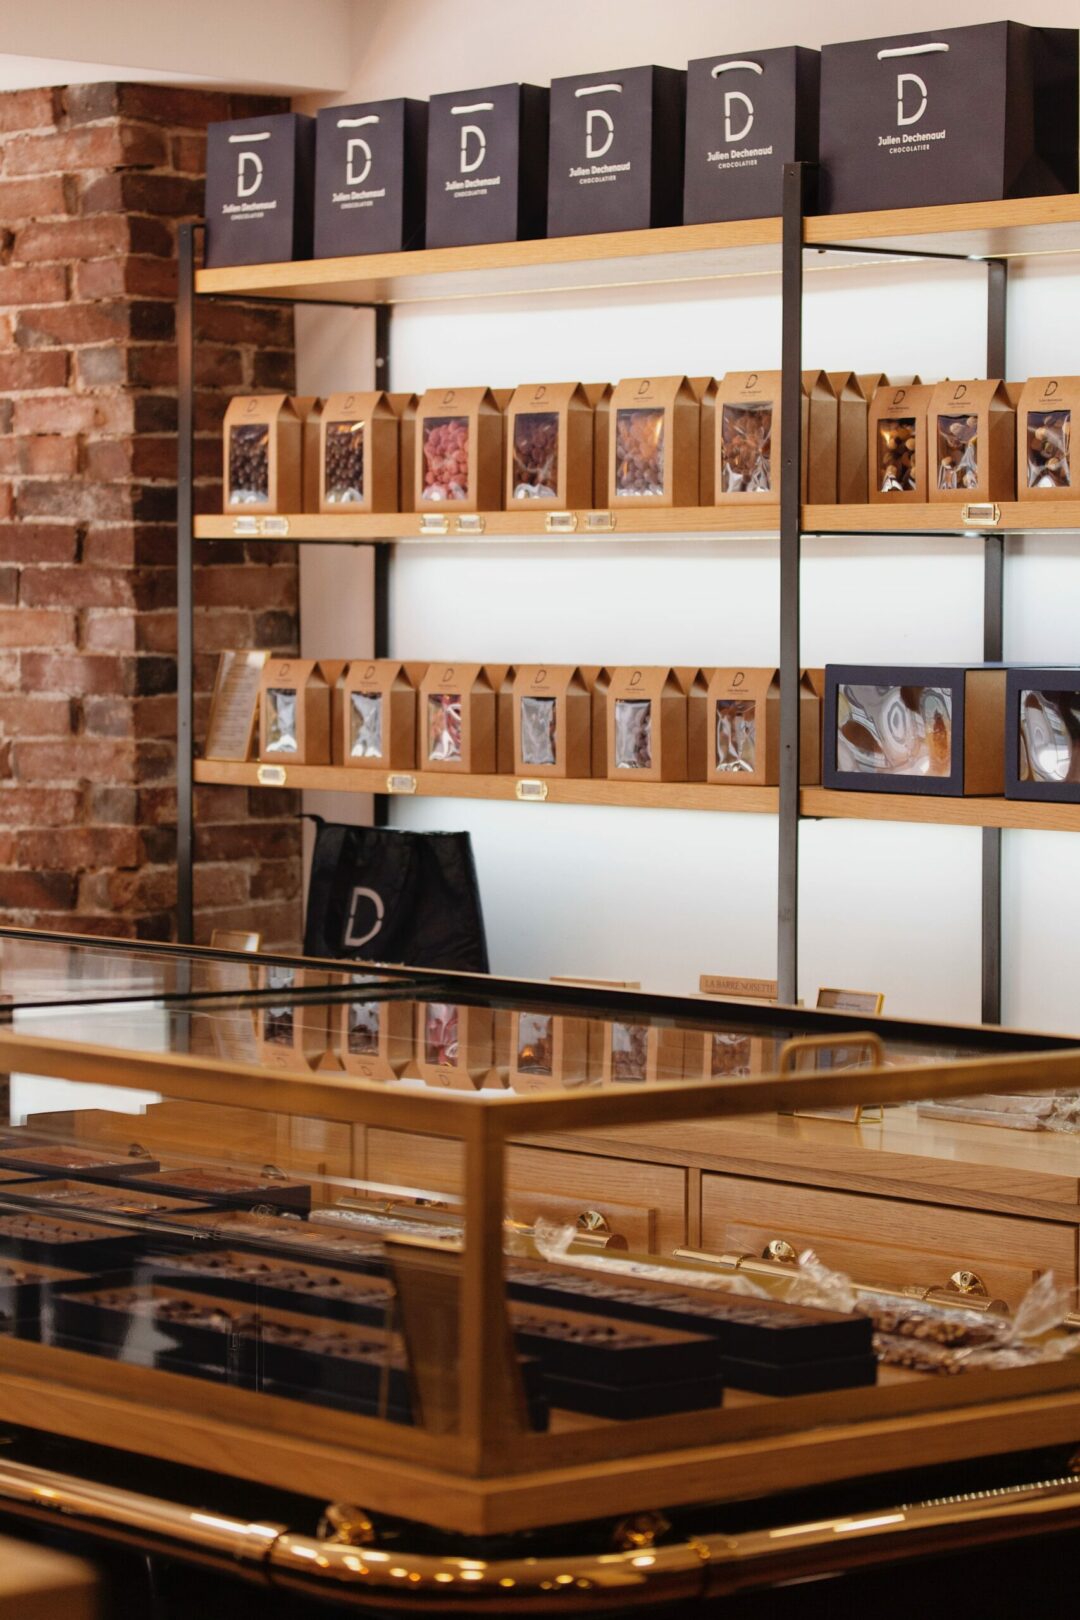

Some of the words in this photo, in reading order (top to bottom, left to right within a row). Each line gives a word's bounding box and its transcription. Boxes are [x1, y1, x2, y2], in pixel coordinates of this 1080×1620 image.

[724, 91, 754, 142] D
[897, 73, 928, 126] D
[461, 125, 486, 173] D
[586, 109, 614, 158] D
[707, 151, 730, 162] Julien
[730, 145, 773, 159] Dechenaud
[878, 135, 901, 146] Julien
[902, 129, 946, 143] Dechenaud
[889, 144, 930, 154] CHOCOLATIER
[237, 151, 263, 198] D
[346, 138, 372, 185] D
[569, 167, 591, 178] Julien
[718, 159, 758, 169] CHOCOLATIER
[344, 886, 385, 947] D
